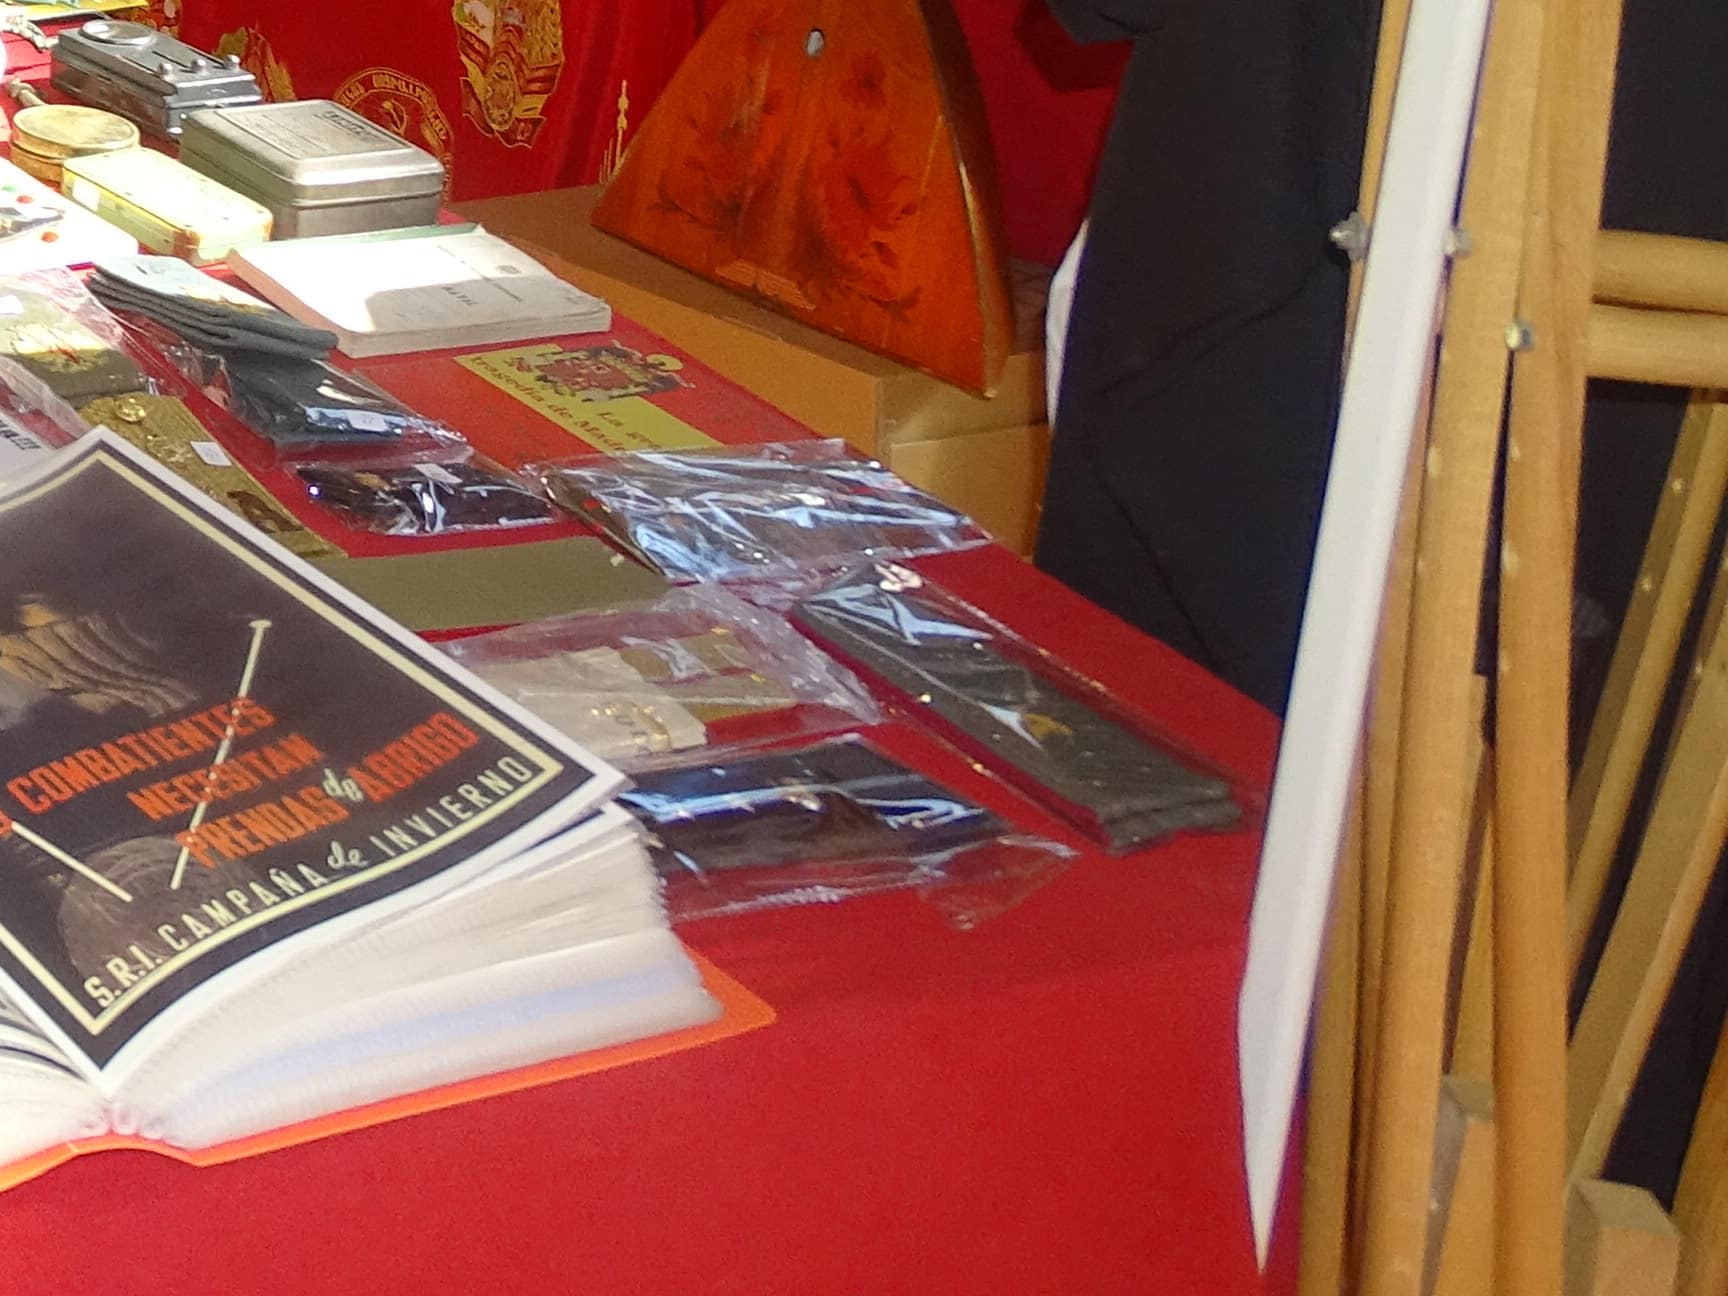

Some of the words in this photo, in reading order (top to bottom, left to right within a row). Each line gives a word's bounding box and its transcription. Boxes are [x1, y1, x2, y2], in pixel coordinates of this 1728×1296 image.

[6, 695, 278, 814] COMBATIENTES
[126, 731, 326, 823] NECESITAN
[174, 785, 351, 869] PRENDAS
[346, 709, 481, 805] ABRIGO
[156, 860, 330, 954] CAMPAÑA
[368, 753, 535, 859] INVIERNO
